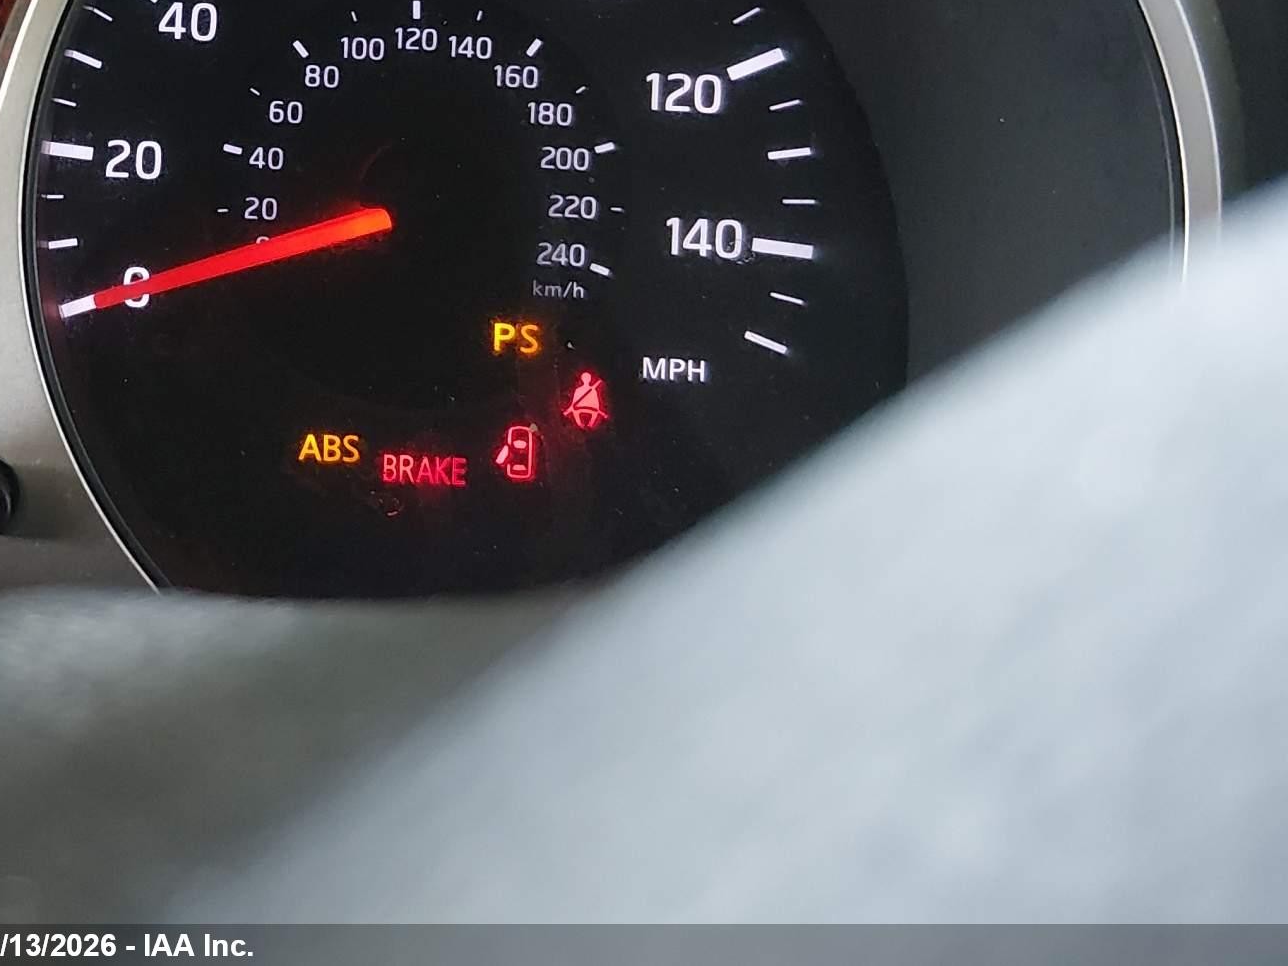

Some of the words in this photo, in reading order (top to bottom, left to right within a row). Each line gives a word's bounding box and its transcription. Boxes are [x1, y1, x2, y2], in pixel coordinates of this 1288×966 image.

[158, 0, 218, 42] 40
[340, 36, 385, 61] 100
[395, 27, 438, 51] 120
[448, 35, 492, 60] 140
[304, 64, 340, 89] 80
[494, 64, 539, 89] 160
[646, 72, 723, 114] 120
[268, 100, 304, 124] 60
[527, 101, 573, 126] 180
[105, 139, 162, 180] 20
[248, 146, 284, 170] 40
[540, 146, 590, 171] 200
[244, 196, 279, 221] 20
[548, 194, 598, 220] 220
[666, 217, 743, 260] 140
[537, 242, 586, 267] 240
[532, 279, 586, 300] km/h
[493, 322, 540, 355] PS
[642, 356, 706, 383] MPH
[299, 433, 360, 463] ABS
[382, 453, 467, 487] BRAKE
